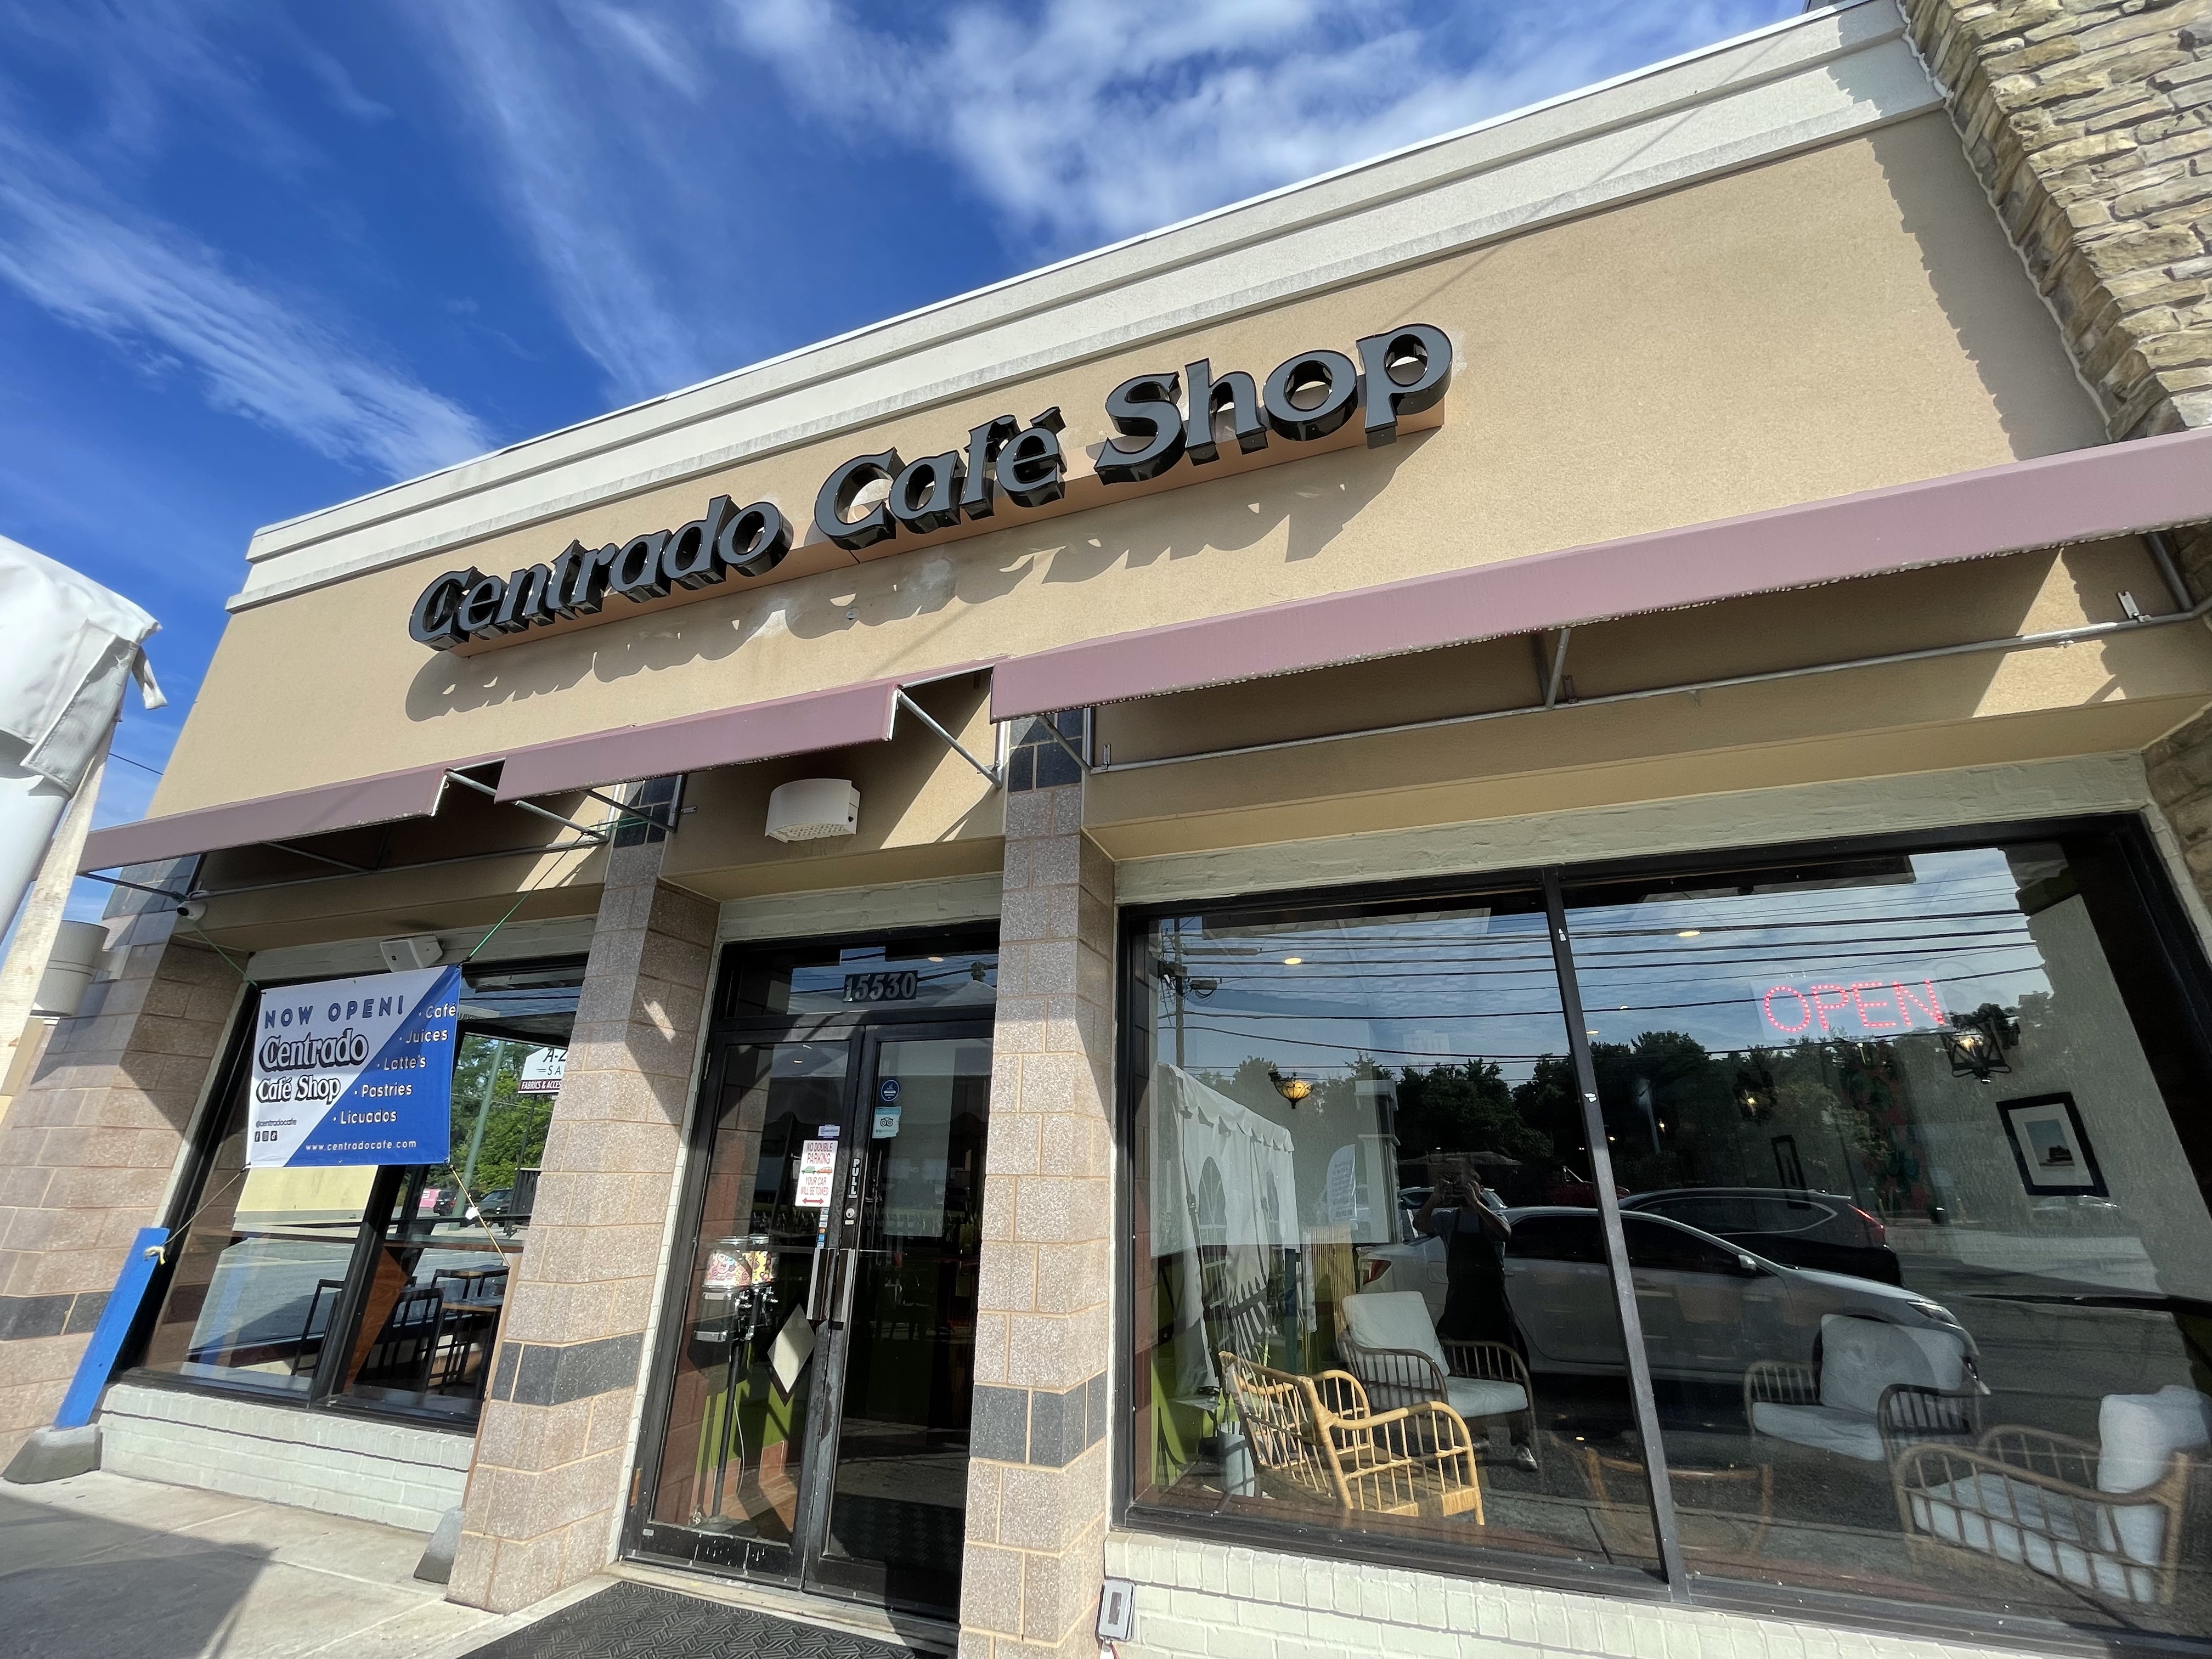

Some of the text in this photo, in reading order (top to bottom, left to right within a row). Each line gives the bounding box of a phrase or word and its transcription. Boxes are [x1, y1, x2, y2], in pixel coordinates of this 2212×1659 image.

[408, 323, 1453, 652] Centrado Café Shop
[844, 972, 917, 1003] 15530
[425, 1002, 456, 1019] Café
[1763, 979, 1946, 1032] OPEN
[265, 1006, 313, 1029] NOW
[405, 1028, 449, 1044] Juices
[259, 1028, 369, 1072] Centrado
[256, 1074, 341, 1105] Café Shop
[362, 1081, 413, 1098] Pastries
[340, 1108, 397, 1124] Licuados
[306, 1140, 417, 1151] www.centradocafe.com
[806, 1142, 833, 1152] NO DOUBLE
[807, 1153, 831, 1164] PARKING
[806, 1177, 826, 1185] YOUR CAR
[851, 1158, 860, 1194] PULL
[800, 1186, 828, 1195] WILL BE TOWED
